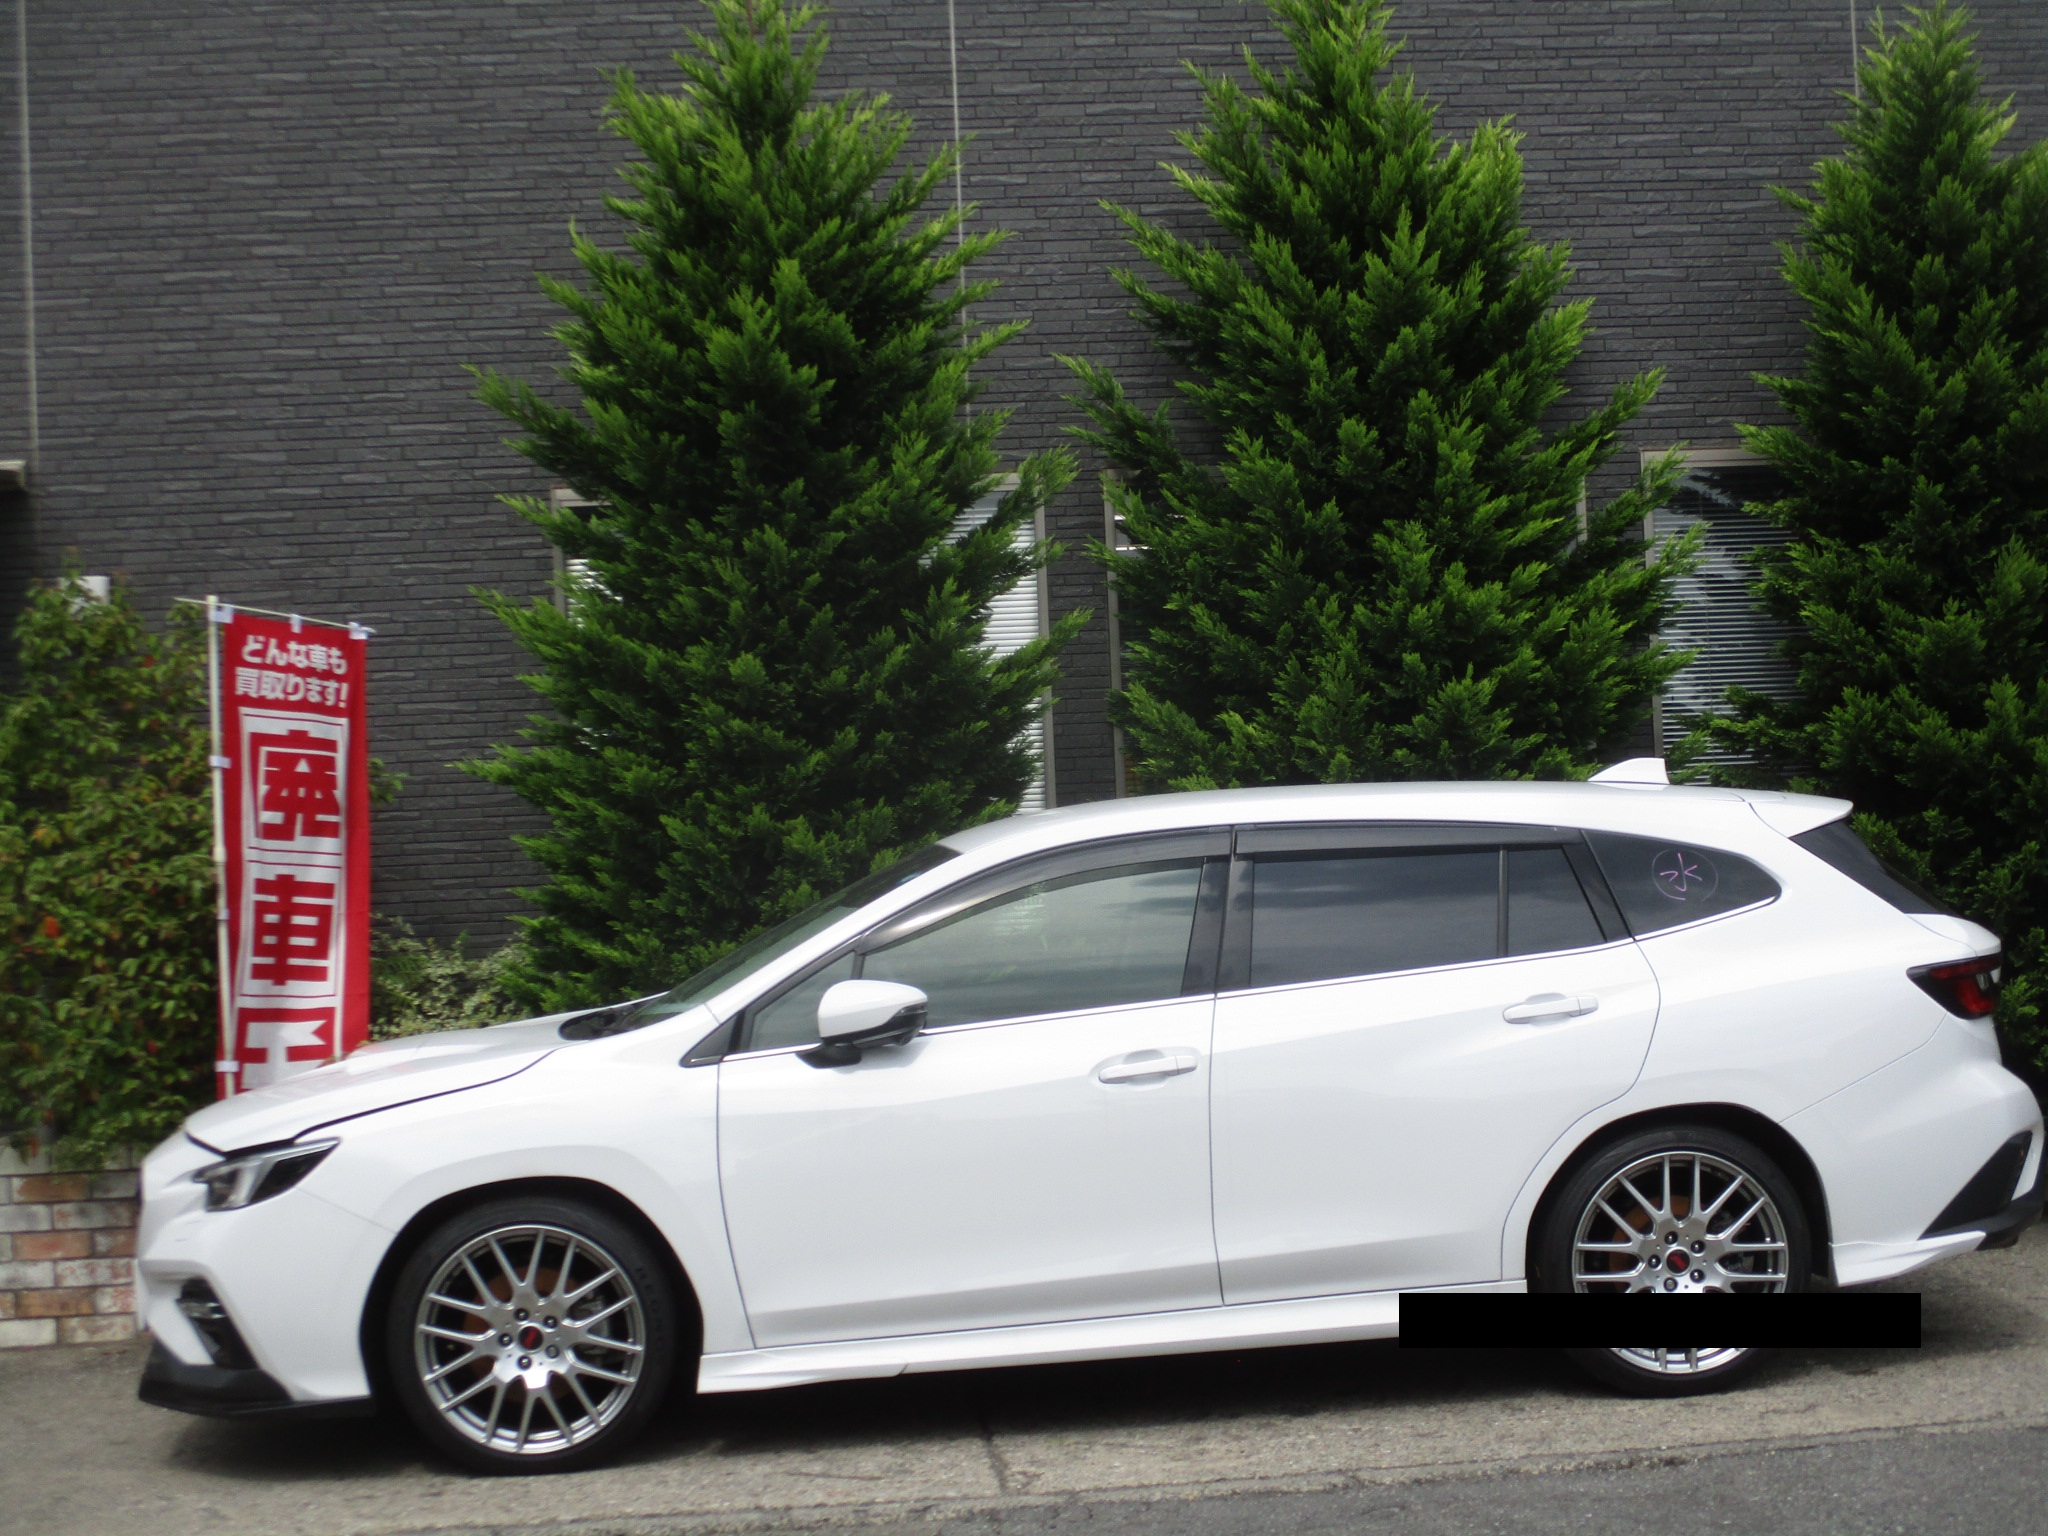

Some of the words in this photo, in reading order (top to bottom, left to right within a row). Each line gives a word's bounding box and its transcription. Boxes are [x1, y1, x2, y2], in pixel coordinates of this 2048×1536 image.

[242, 634, 348, 675] どんな車も
